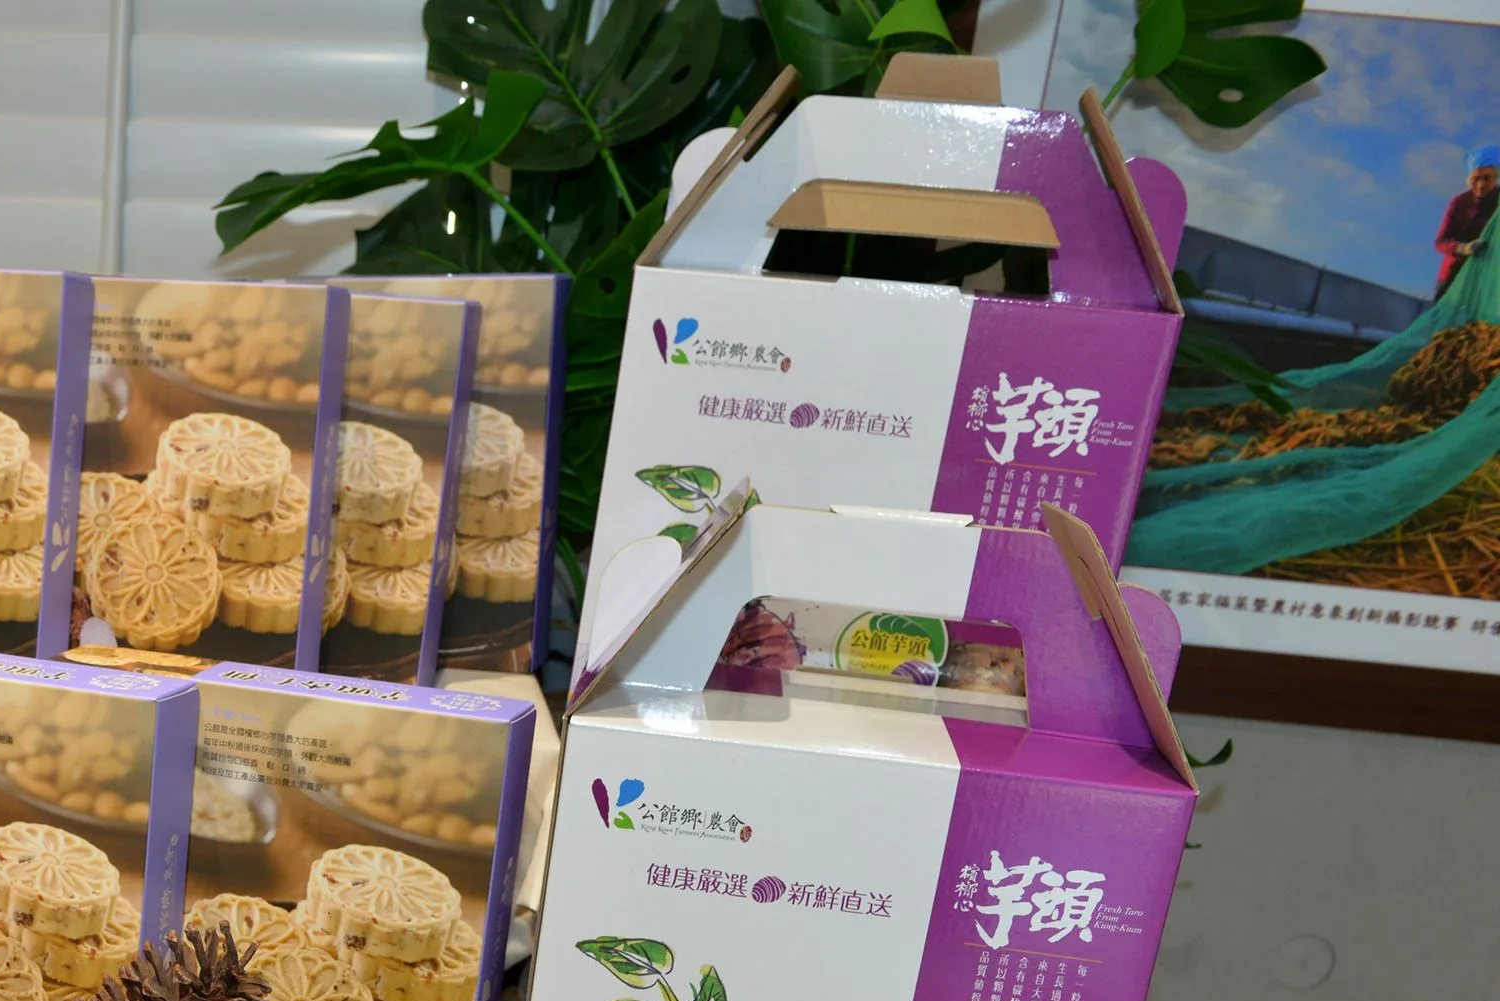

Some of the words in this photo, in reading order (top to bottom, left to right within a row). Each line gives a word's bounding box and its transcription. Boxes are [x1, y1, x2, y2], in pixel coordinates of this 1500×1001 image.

[698, 394, 787, 425] 健康嚴選
[820, 407, 913, 438] 新鮮直送
[985, 371, 1101, 465] 芋頭
[851, 629, 929, 657] 公館芋頭
[646, 863, 748, 898] 健康嚴選
[787, 881, 893, 918] 新鮮直送
[954, 864, 980, 912] 檳榔心
[975, 850, 1107, 950] 芋頭
[1098, 903, 1122, 916] Fresh
[1125, 908, 1144, 917] Taro
[1094, 922, 1143, 935] Kung-Kuan
[1096, 912, 1119, 923] From
